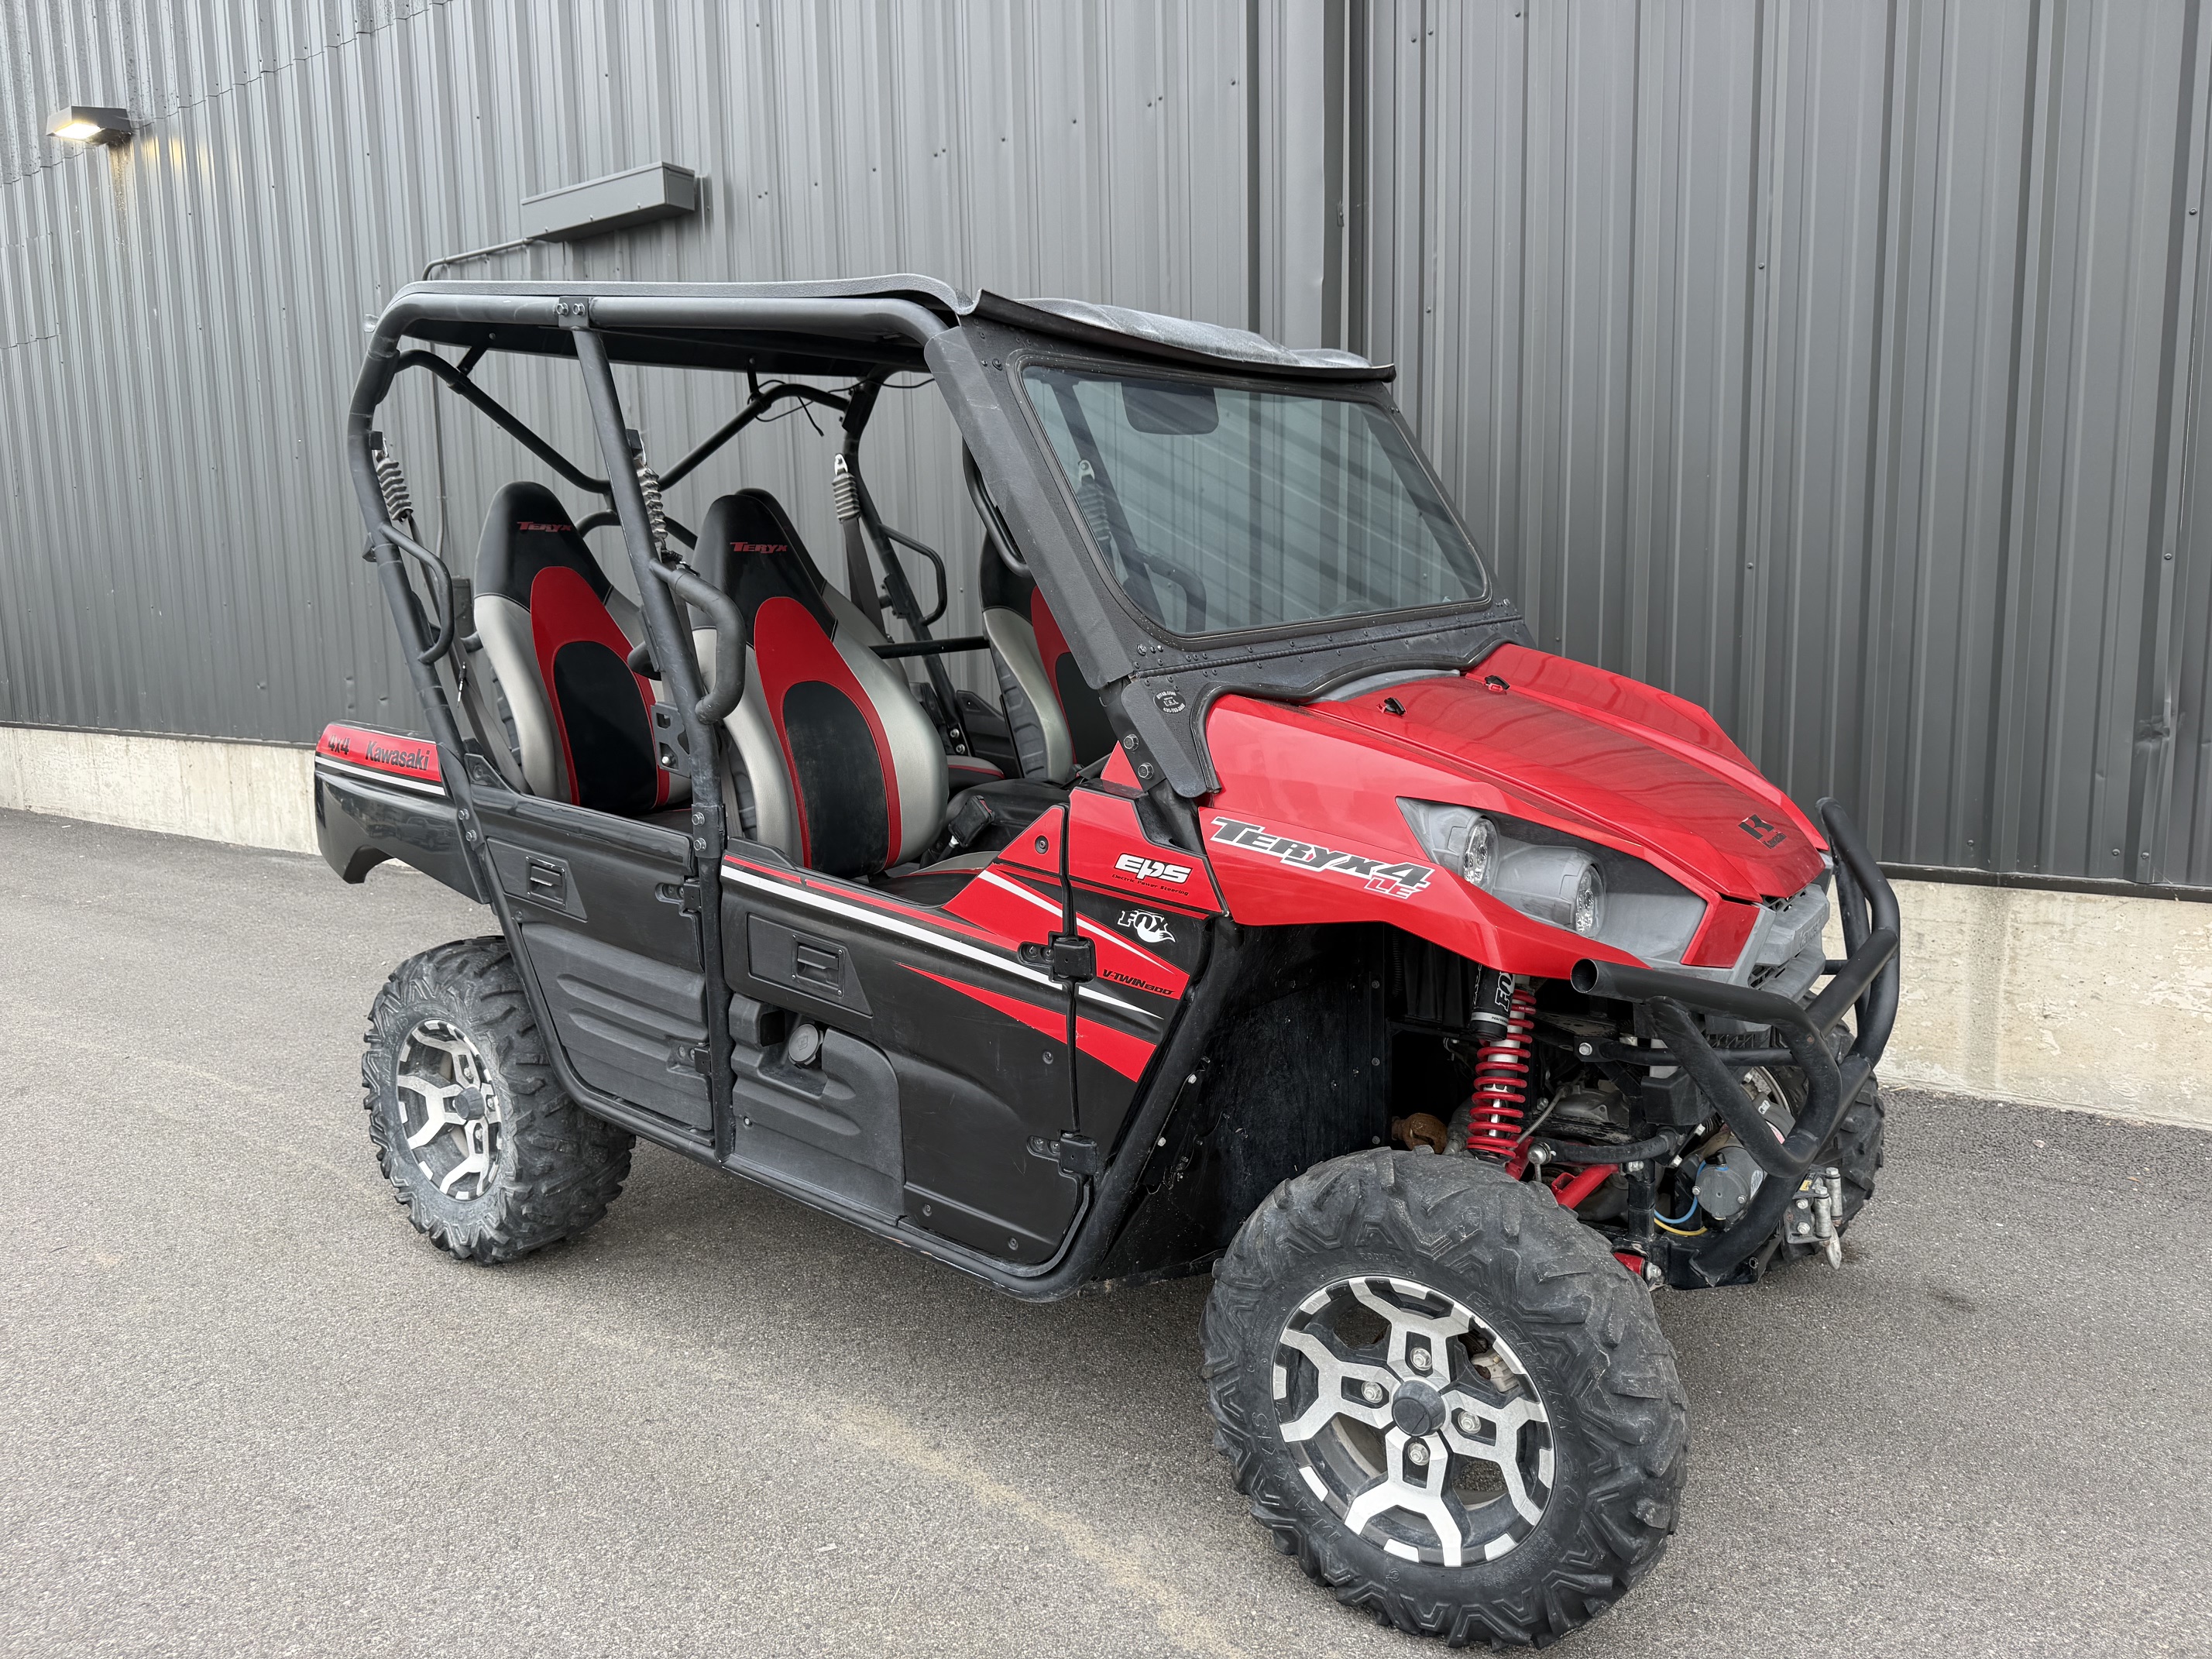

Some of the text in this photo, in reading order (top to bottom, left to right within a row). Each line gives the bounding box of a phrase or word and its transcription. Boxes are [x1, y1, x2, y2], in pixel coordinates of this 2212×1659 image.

[517, 520, 572, 533] TERYX
[730, 541, 788, 554] TERYX
[328, 733, 351, 755] 4x4
[365, 740, 431, 771] Kawasaki
[1210, 816, 1435, 889] TERYX4
[1114, 853, 1194, 884] EPS
[1111, 874, 1190, 896] Electric Power Steering
[1363, 875, 1424, 900] LE
[1118, 909, 1172, 937] FOX
[1495, 971, 1515, 1012] FO
